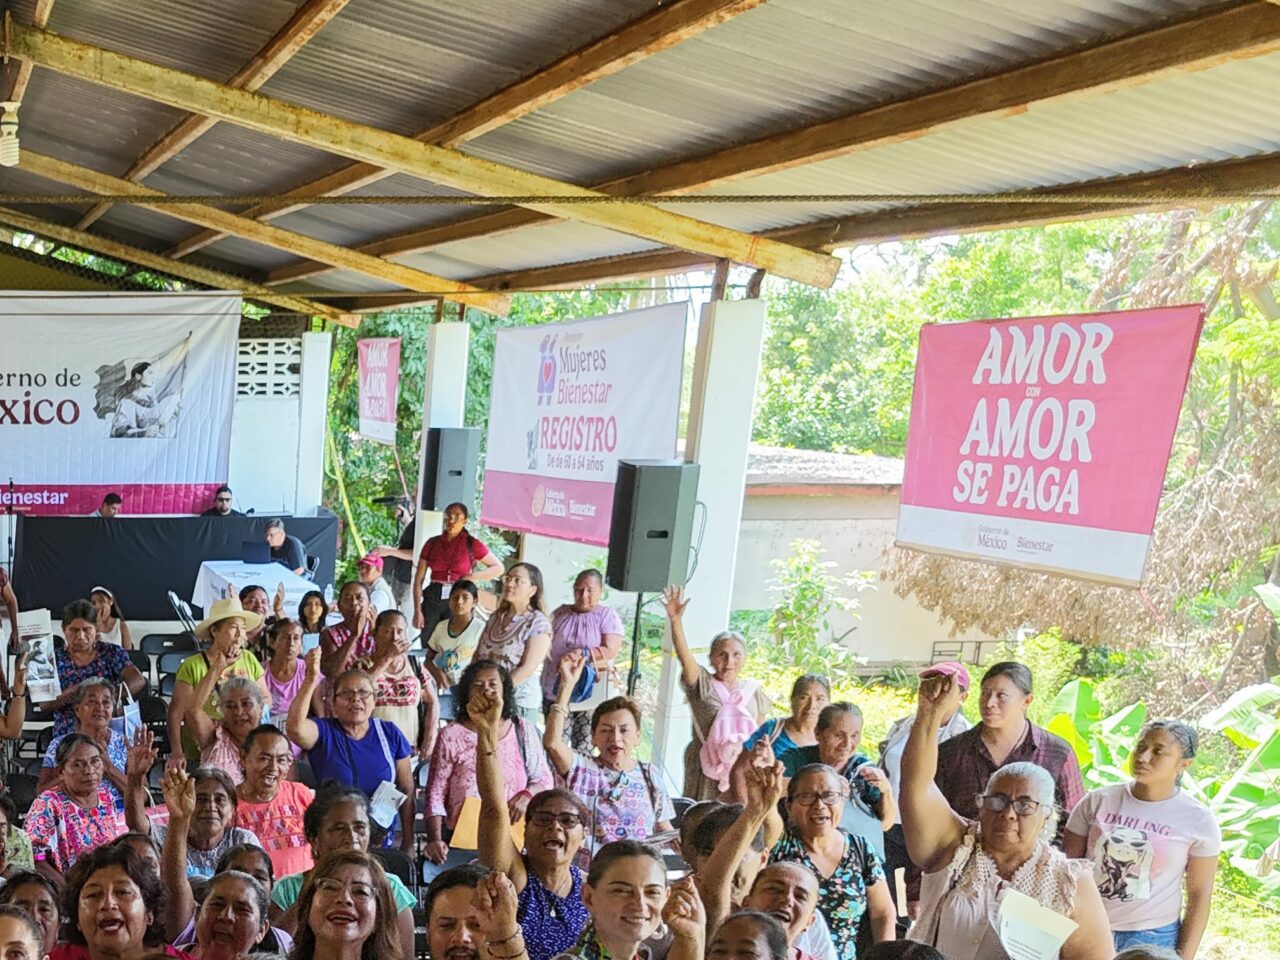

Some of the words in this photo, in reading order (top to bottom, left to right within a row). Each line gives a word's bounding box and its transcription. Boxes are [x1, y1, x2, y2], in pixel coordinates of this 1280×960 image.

[560, 344, 606, 381] Mujeres
[972, 322, 1114, 385] AMOR
[55, 368, 81, 388] de
[557, 378, 612, 405] Bienestar
[1025, 386, 1042, 397] CON
[540, 415, 617, 453] REGISTRO
[959, 396, 1096, 463] AMOR
[586, 456, 604, 472] años
[952, 459, 993, 505] SE
[996, 464, 1079, 515] PAGA
[569, 499, 596, 517] Bienestar
[977, 533, 1007, 550] México
[1016, 536, 1054, 552] Bienestar
[1104, 812, 1171, 836] DARLING
